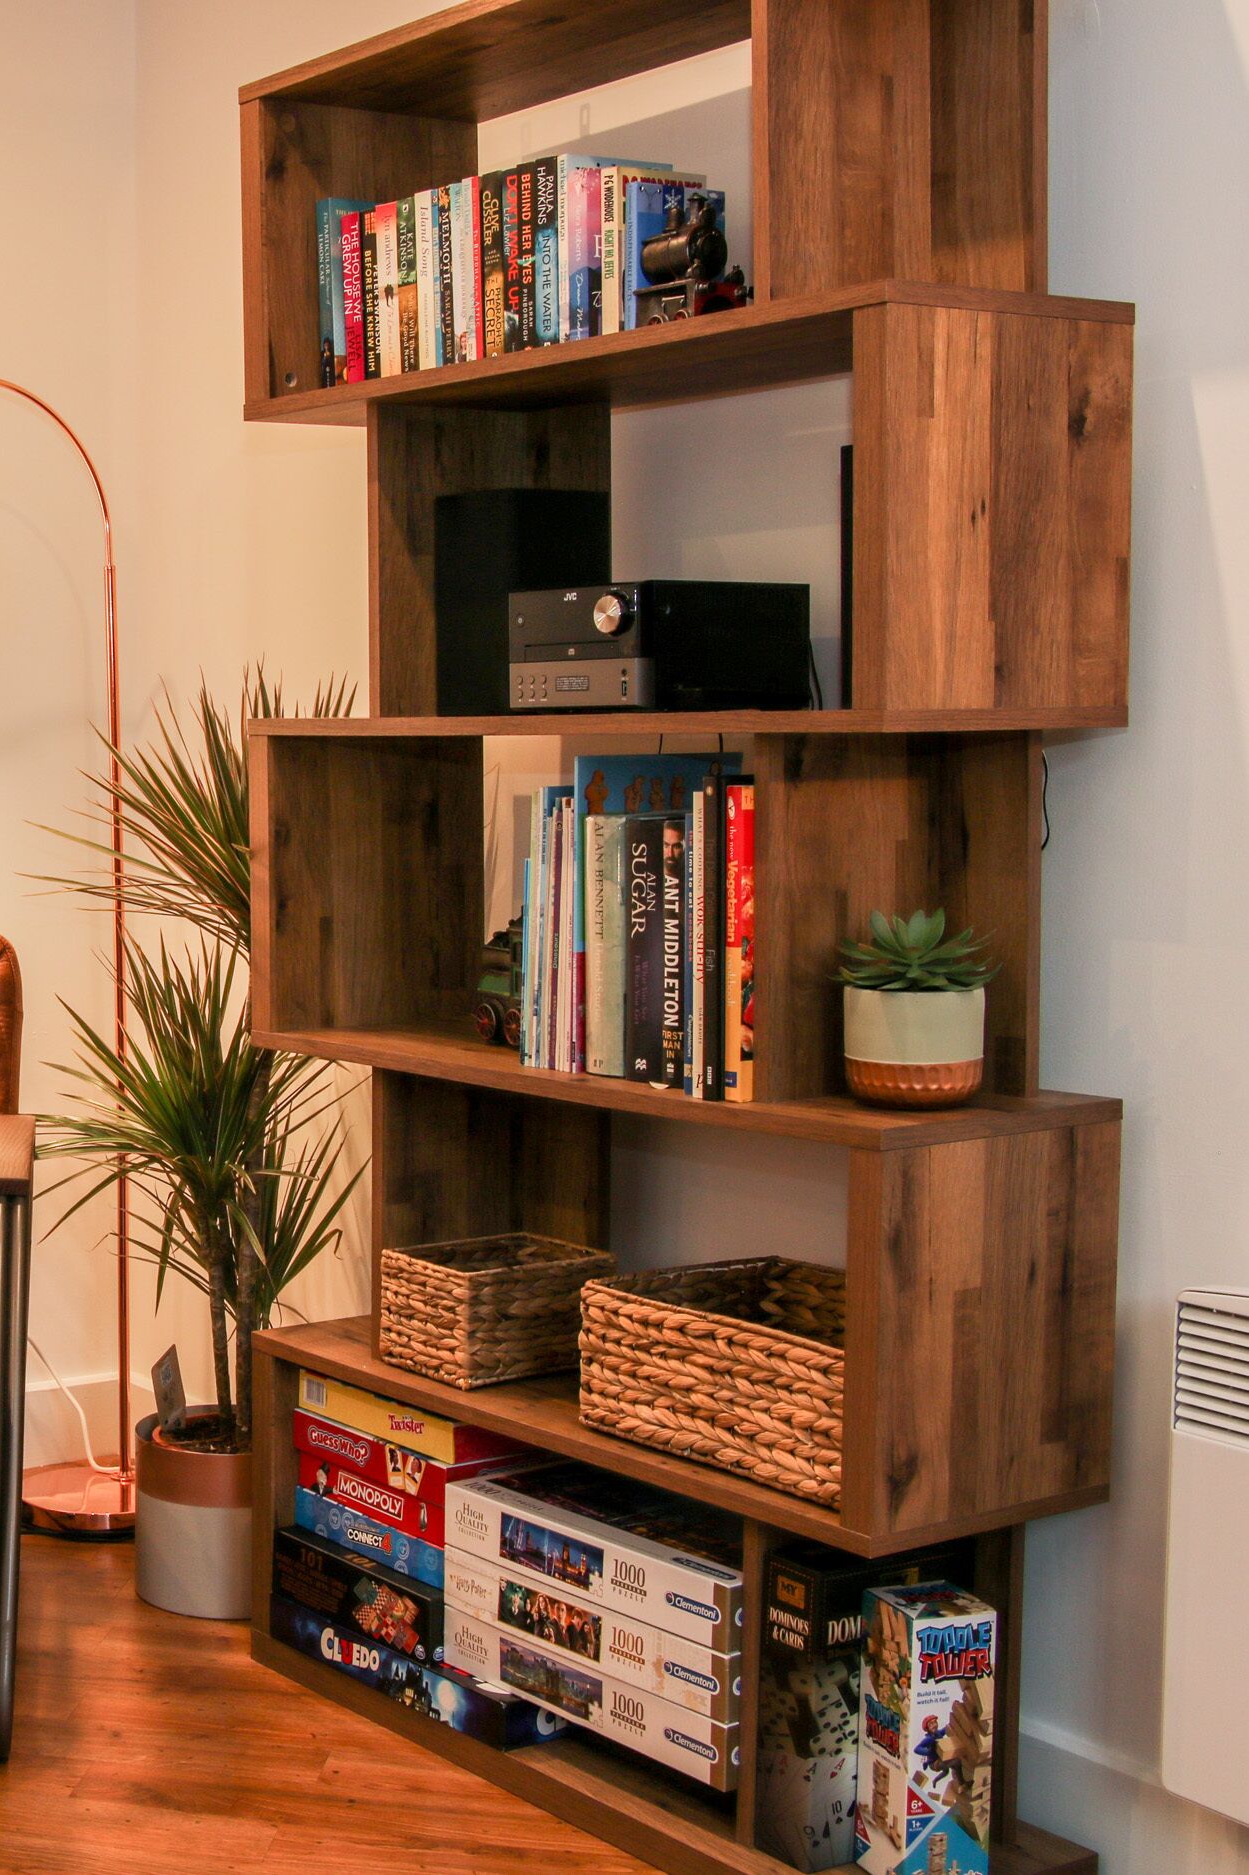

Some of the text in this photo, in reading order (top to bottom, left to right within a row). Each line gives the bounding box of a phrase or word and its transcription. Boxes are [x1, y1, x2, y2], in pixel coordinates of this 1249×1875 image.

[537, 167, 547, 225] HAWKINS
[545, 175, 554, 213] PAULA
[604, 186, 614, 223] WODEHOUSE
[482, 190, 492, 246] CUSSLER
[490, 198, 499, 233] CLIVE
[503, 207, 512, 256] Liz Lawler
[521, 173, 532, 284] BEHIND HER EYES
[399, 221, 409, 279] ATKINSON
[405, 232, 414, 260] KATE
[419, 207, 430, 277] Island Song
[441, 211, 451, 285] MELMOTH
[603, 230, 614, 247] RIGHT
[384, 235, 393, 276] andrews
[507, 229, 519, 281] WAKE
[603, 260, 614, 280] JEEVES
[341, 233, 353, 315] GREW UP IN
[350, 222, 362, 323] THE HOUSE WE
[542, 235, 552, 333] INTO THE WATER
[364, 250, 376, 372] BEFORE SHE KNEW HIM
[508, 287, 519, 311] UP
[408, 319, 416, 337] Will
[444, 290, 453, 359] SARAH PERRY
[485, 288, 496, 348] SECRET
[494, 287, 503, 347] PHARAOH'S
[346, 326, 356, 372] JEWELL
[354, 334, 362, 360] LISA
[563, 592, 577, 601] JVC
[594, 822, 604, 863] ALAN
[729, 825, 737, 840] the
[594, 869, 604, 939] BENNETT
[631, 842, 647, 939] SUGAR
[646, 871, 656, 912] ALAN
[727, 860, 738, 942] Vegetarian
[696, 894, 704, 926] WOK
[664, 874, 679, 1026] ANT MIDDLETON
[706, 949, 716, 972] Fish
[666, 1050, 675, 1058] IN
[388, 1414, 424, 1435] Twister
[339, 1478, 402, 1515] MONOPOLY
[462, 1502, 484, 1521] HIGH
[455, 1509, 489, 1533] QUALITY
[347, 1528, 392, 1555] CONNECT 4
[613, 1559, 646, 1588] 1000
[612, 1587, 644, 1603] PUZZLE
[675, 1597, 717, 1619] Clementoni
[461, 1625, 483, 1646] HIGH
[769, 1606, 809, 1636] DOMINOES
[320, 1627, 381, 1672] CLUEDO
[454, 1632, 489, 1657] QUALITY
[612, 1626, 644, 1656] 1000
[772, 1625, 805, 1651] & CARDS
[916, 1620, 992, 1655] TOPPLE
[611, 1654, 642, 1672] PUZZLE
[673, 1666, 715, 1690] Clementoni
[918, 1648, 992, 1684] TOWER
[612, 1691, 644, 1721] 1000
[612, 1718, 643, 1737] PUZZLE
[673, 1733, 714, 1757] Clementoni
[831, 1800, 843, 1815] 10
[911, 1800, 923, 1809] 6+
[911, 1820, 921, 1828] 1+
